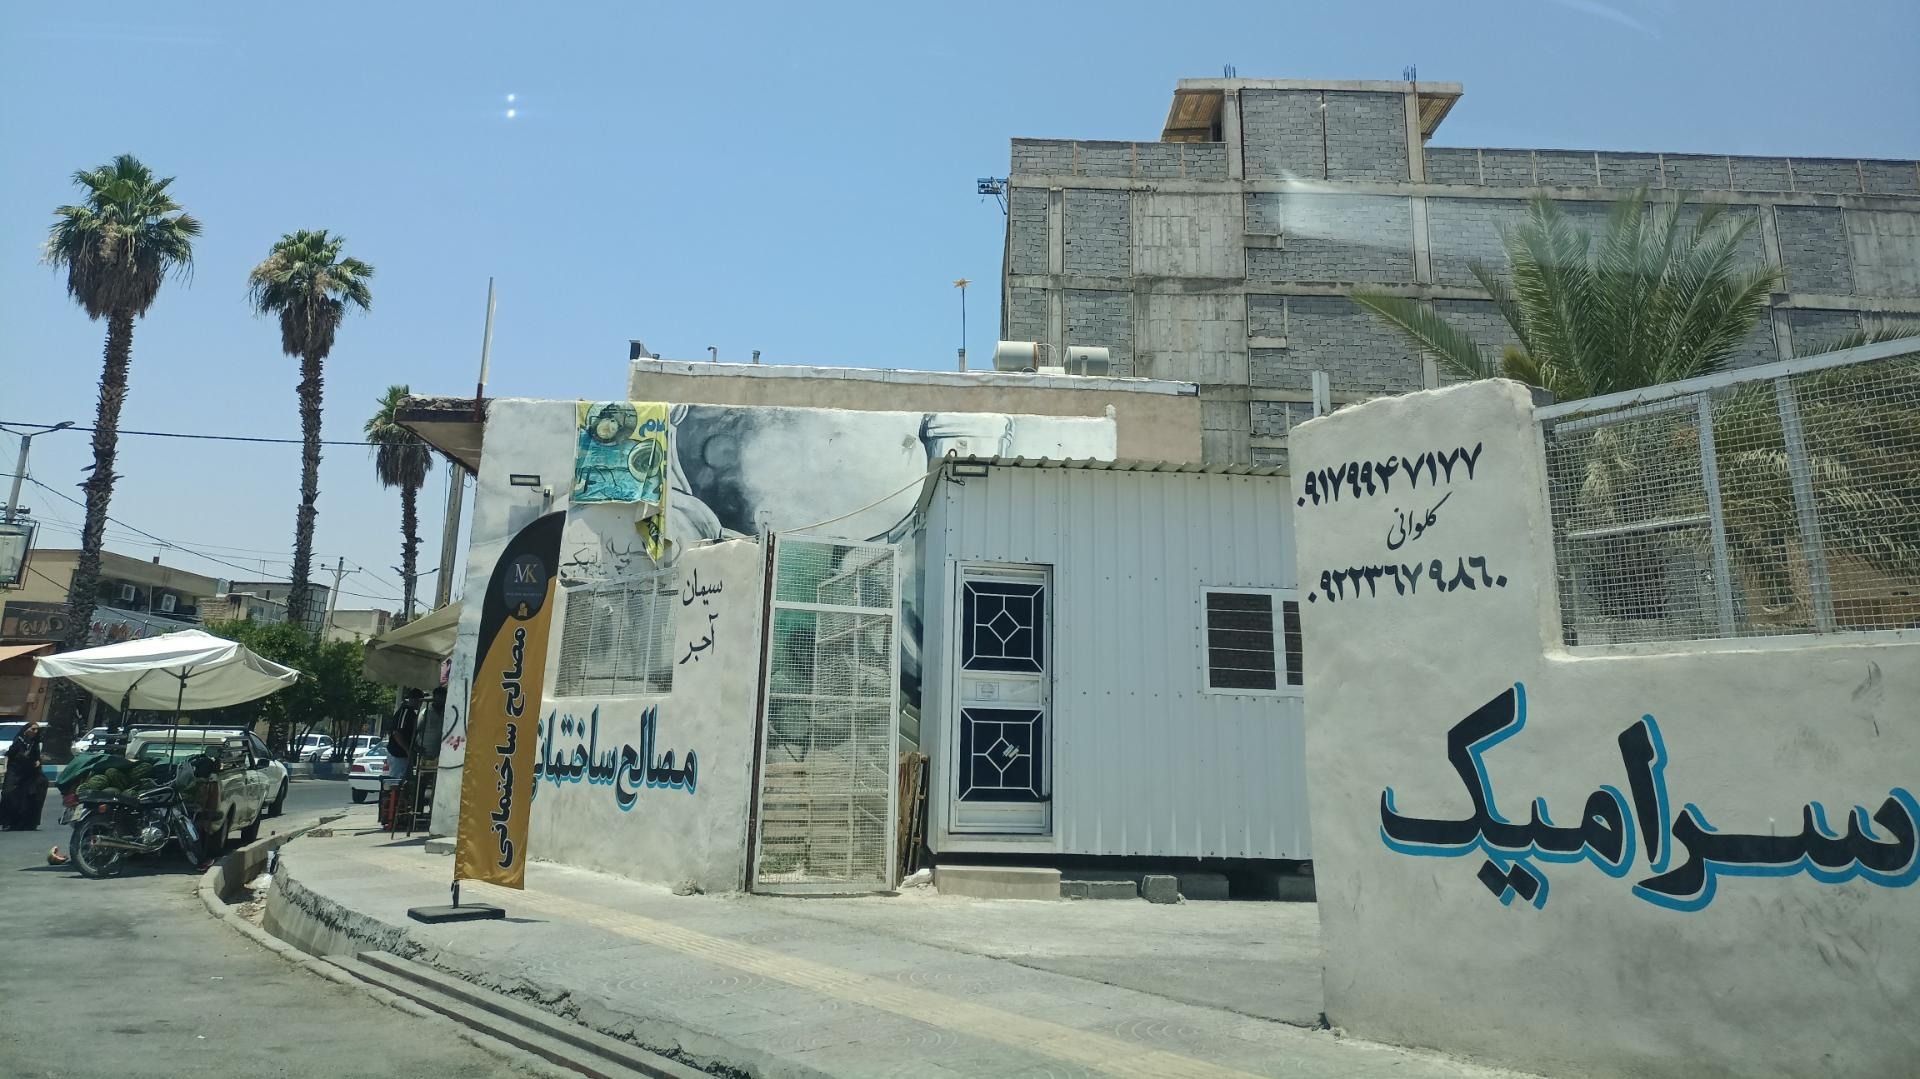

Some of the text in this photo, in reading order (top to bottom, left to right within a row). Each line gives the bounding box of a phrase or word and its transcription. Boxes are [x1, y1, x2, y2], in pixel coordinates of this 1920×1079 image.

[513, 563, 537, 583] MK
[682, 568, 723, 607] سیمان
[501, 626, 528, 719] مصالح
[679, 612, 719, 665] آجر
[491, 722, 518, 869] ساختمانی
[531, 703, 698, 812] مصالح ساختمان
[1380, 681, 1920, 912] سرامیک
